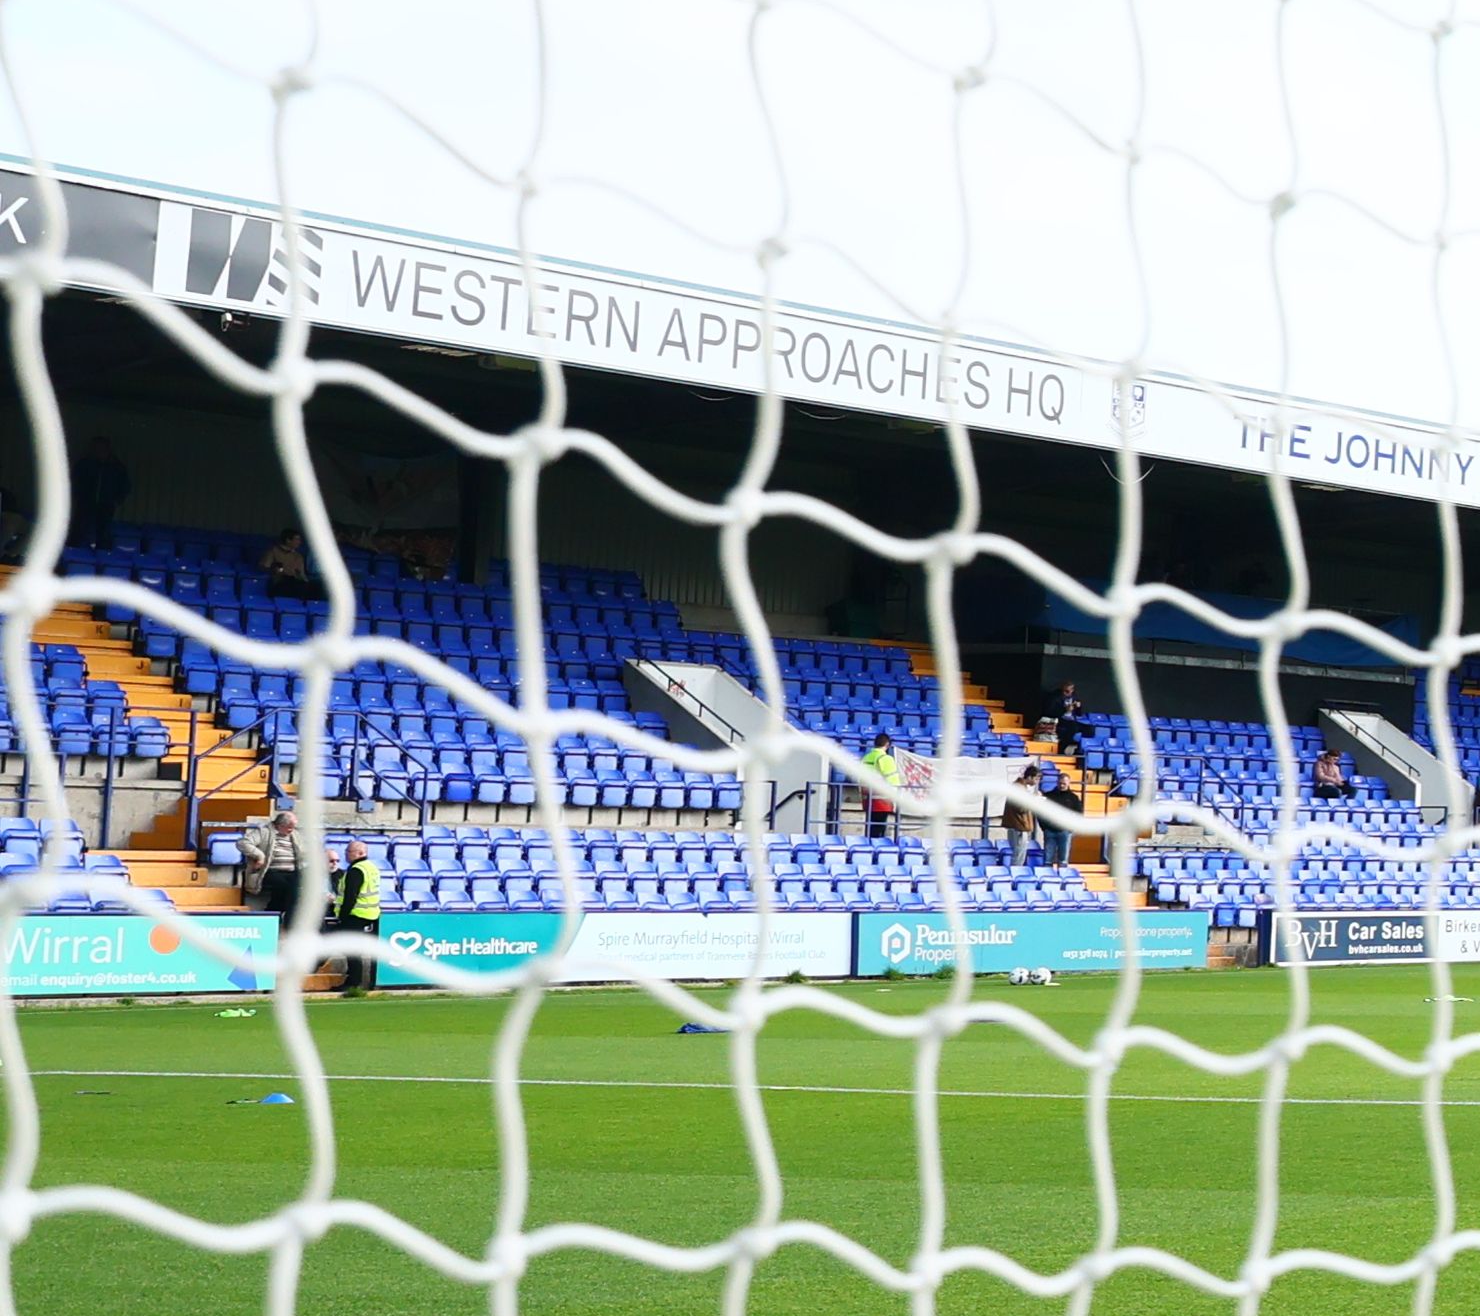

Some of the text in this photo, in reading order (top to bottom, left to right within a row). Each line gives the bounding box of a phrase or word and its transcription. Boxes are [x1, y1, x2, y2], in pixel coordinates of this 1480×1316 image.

[352, 250, 1066, 425] WESTERN APPROACHES HQ
[1325, 431, 1475, 486] JOHNNY
[1348, 921, 1424, 941] Car Sales
[423, 937, 538, 960] Spire Healthcare
[598, 931, 805, 953] Spire Murrayfield Hospita Wirral
[1348, 942, 1424, 955] bvhcarsales.co.uk
[1460, 940, 1468, 953] &
[40, 971, 197, 988] enquiry@foster4.co.uk
